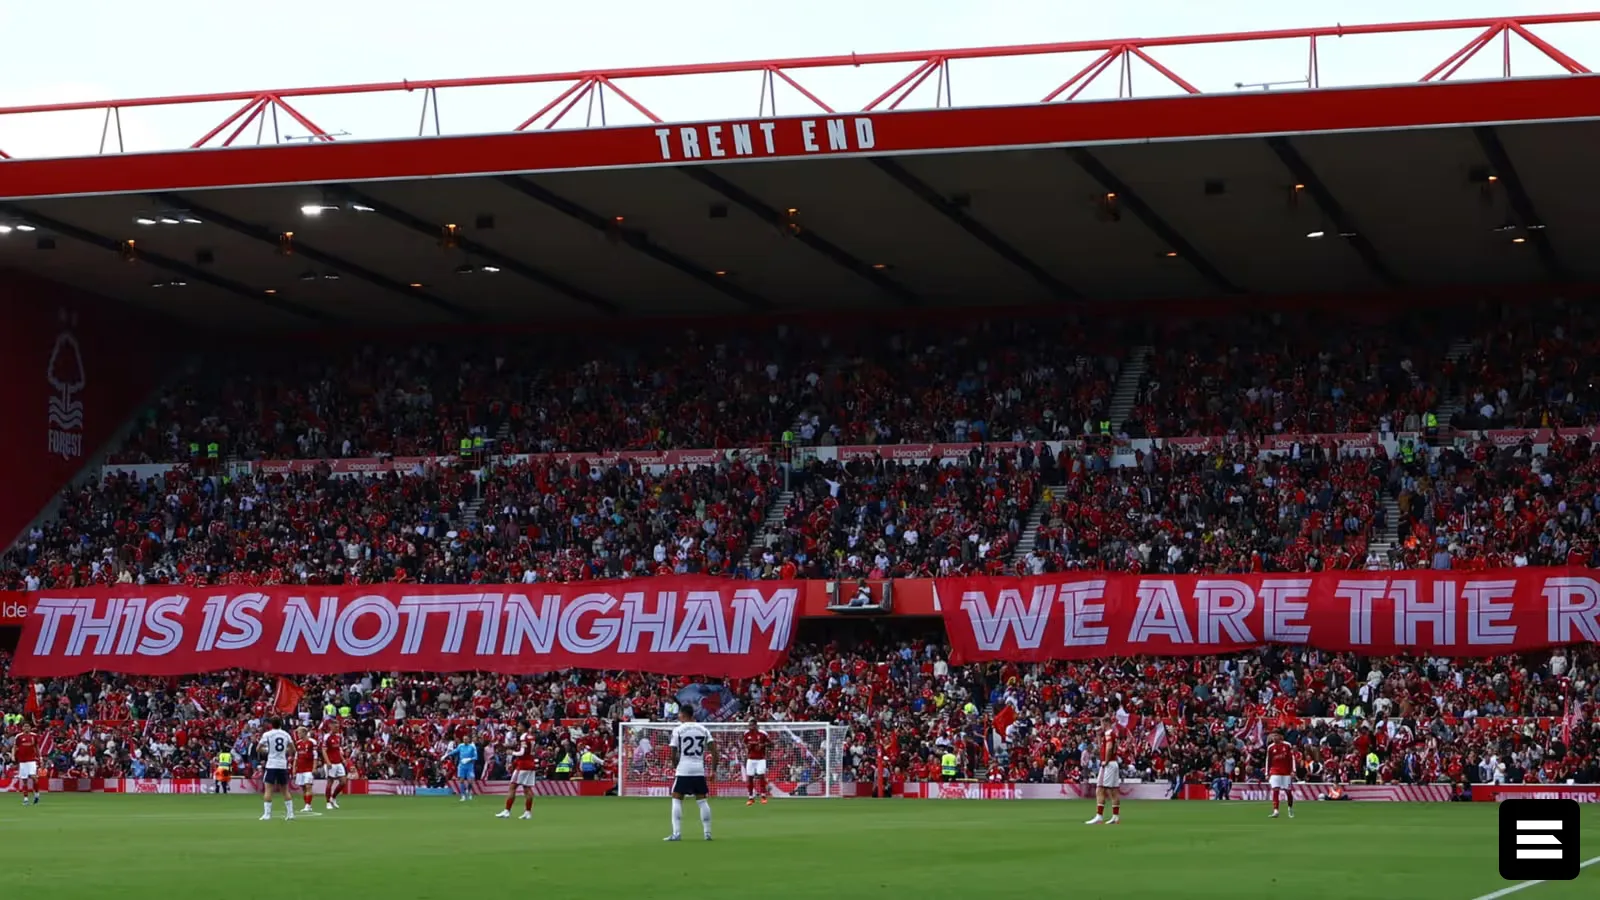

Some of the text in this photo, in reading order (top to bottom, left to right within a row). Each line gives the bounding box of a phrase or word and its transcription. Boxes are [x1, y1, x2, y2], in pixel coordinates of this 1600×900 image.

[655, 117, 875, 160] TRENT END
[33, 588, 798, 657] THIS IS NOTTINGHAM
[960, 580, 1109, 651] WE
[1128, 579, 1312, 643] ARE
[1335, 579, 1517, 646] THE
[275, 737, 284, 752] 8
[683, 736, 706, 756] 23
